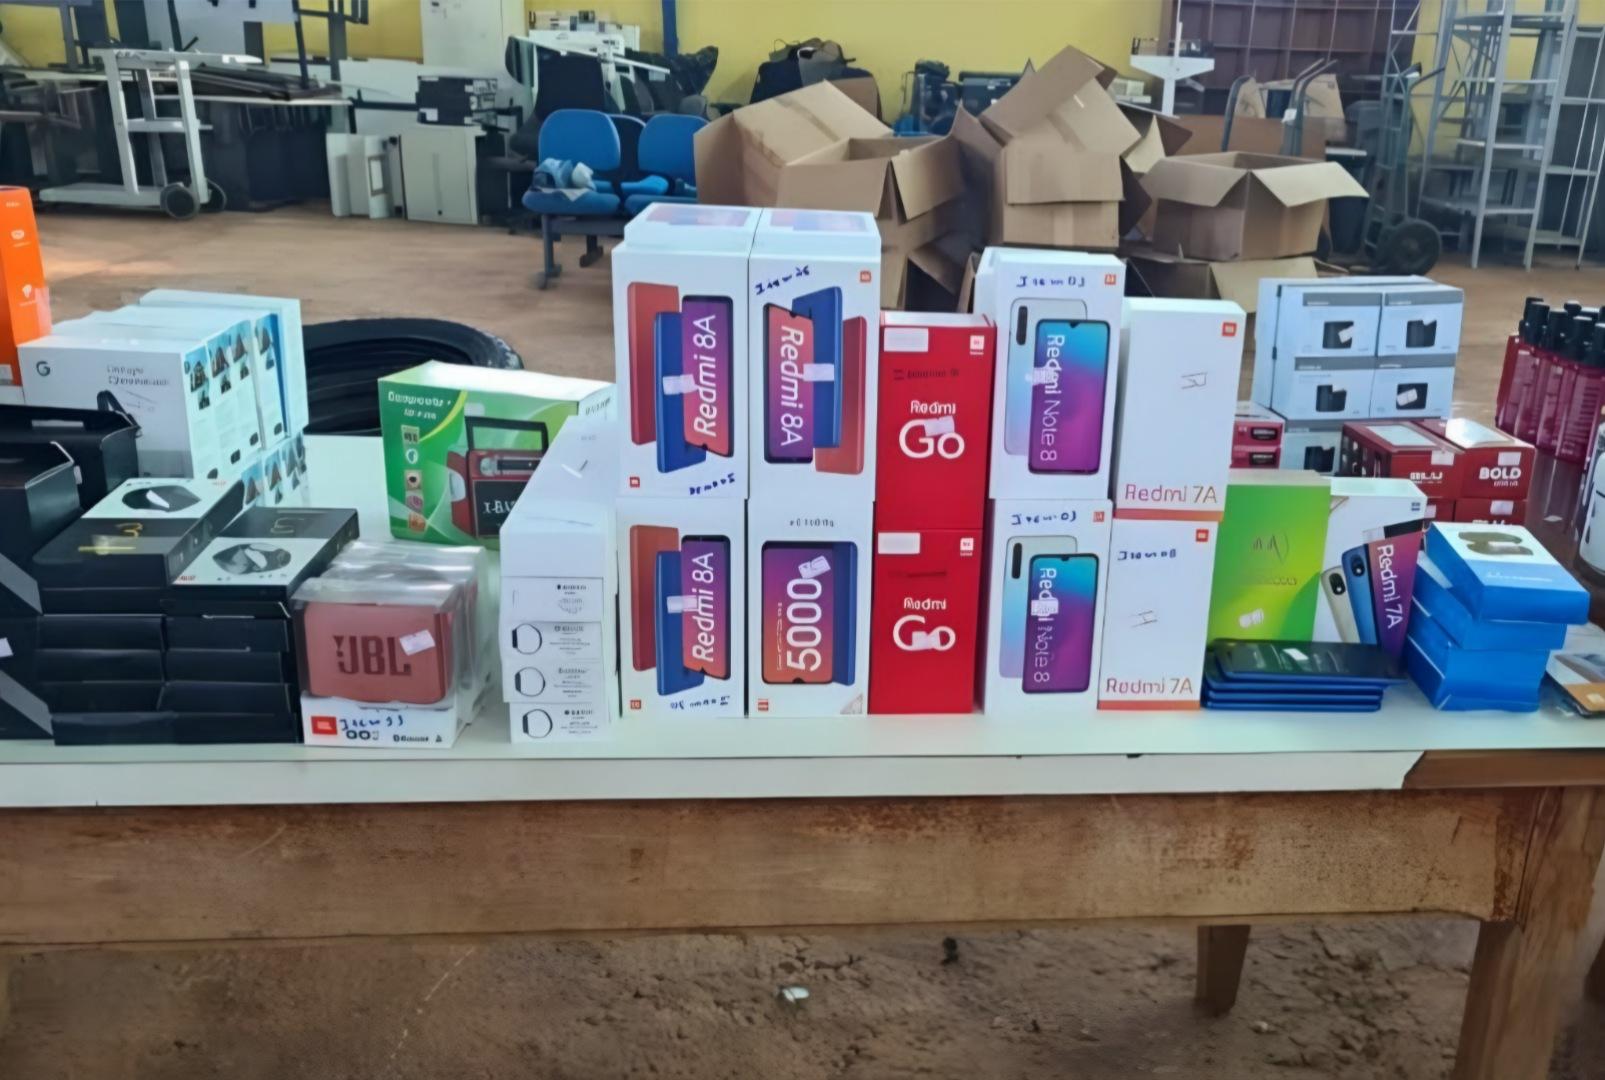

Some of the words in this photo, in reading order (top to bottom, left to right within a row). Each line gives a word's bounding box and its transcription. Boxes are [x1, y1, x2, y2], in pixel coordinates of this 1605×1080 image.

[692, 314, 717, 350] 8A
[780, 325, 804, 409] Redmi
[693, 354, 717, 437] Redmi
[910, 400, 957, 415] Redmi
[780, 412, 804, 447] 8A
[898, 418, 966, 459] Go
[1041, 399, 1061, 446] Note
[1039, 450, 1058, 461] 8
[1478, 466, 1522, 480] BOLD
[1124, 483, 1187, 503] Redmi
[1193, 485, 1217, 504] 7A
[692, 552, 714, 584] 8A
[1376, 544, 1401, 603] Redmi
[692, 588, 714, 662] Redmi
[786, 578, 823, 672] 5000
[1385, 603, 1404, 630] 7A
[332, 635, 412, 676] JBL
[1033, 671, 1051, 683] 8
[1170, 677, 1193, 695] 7A
